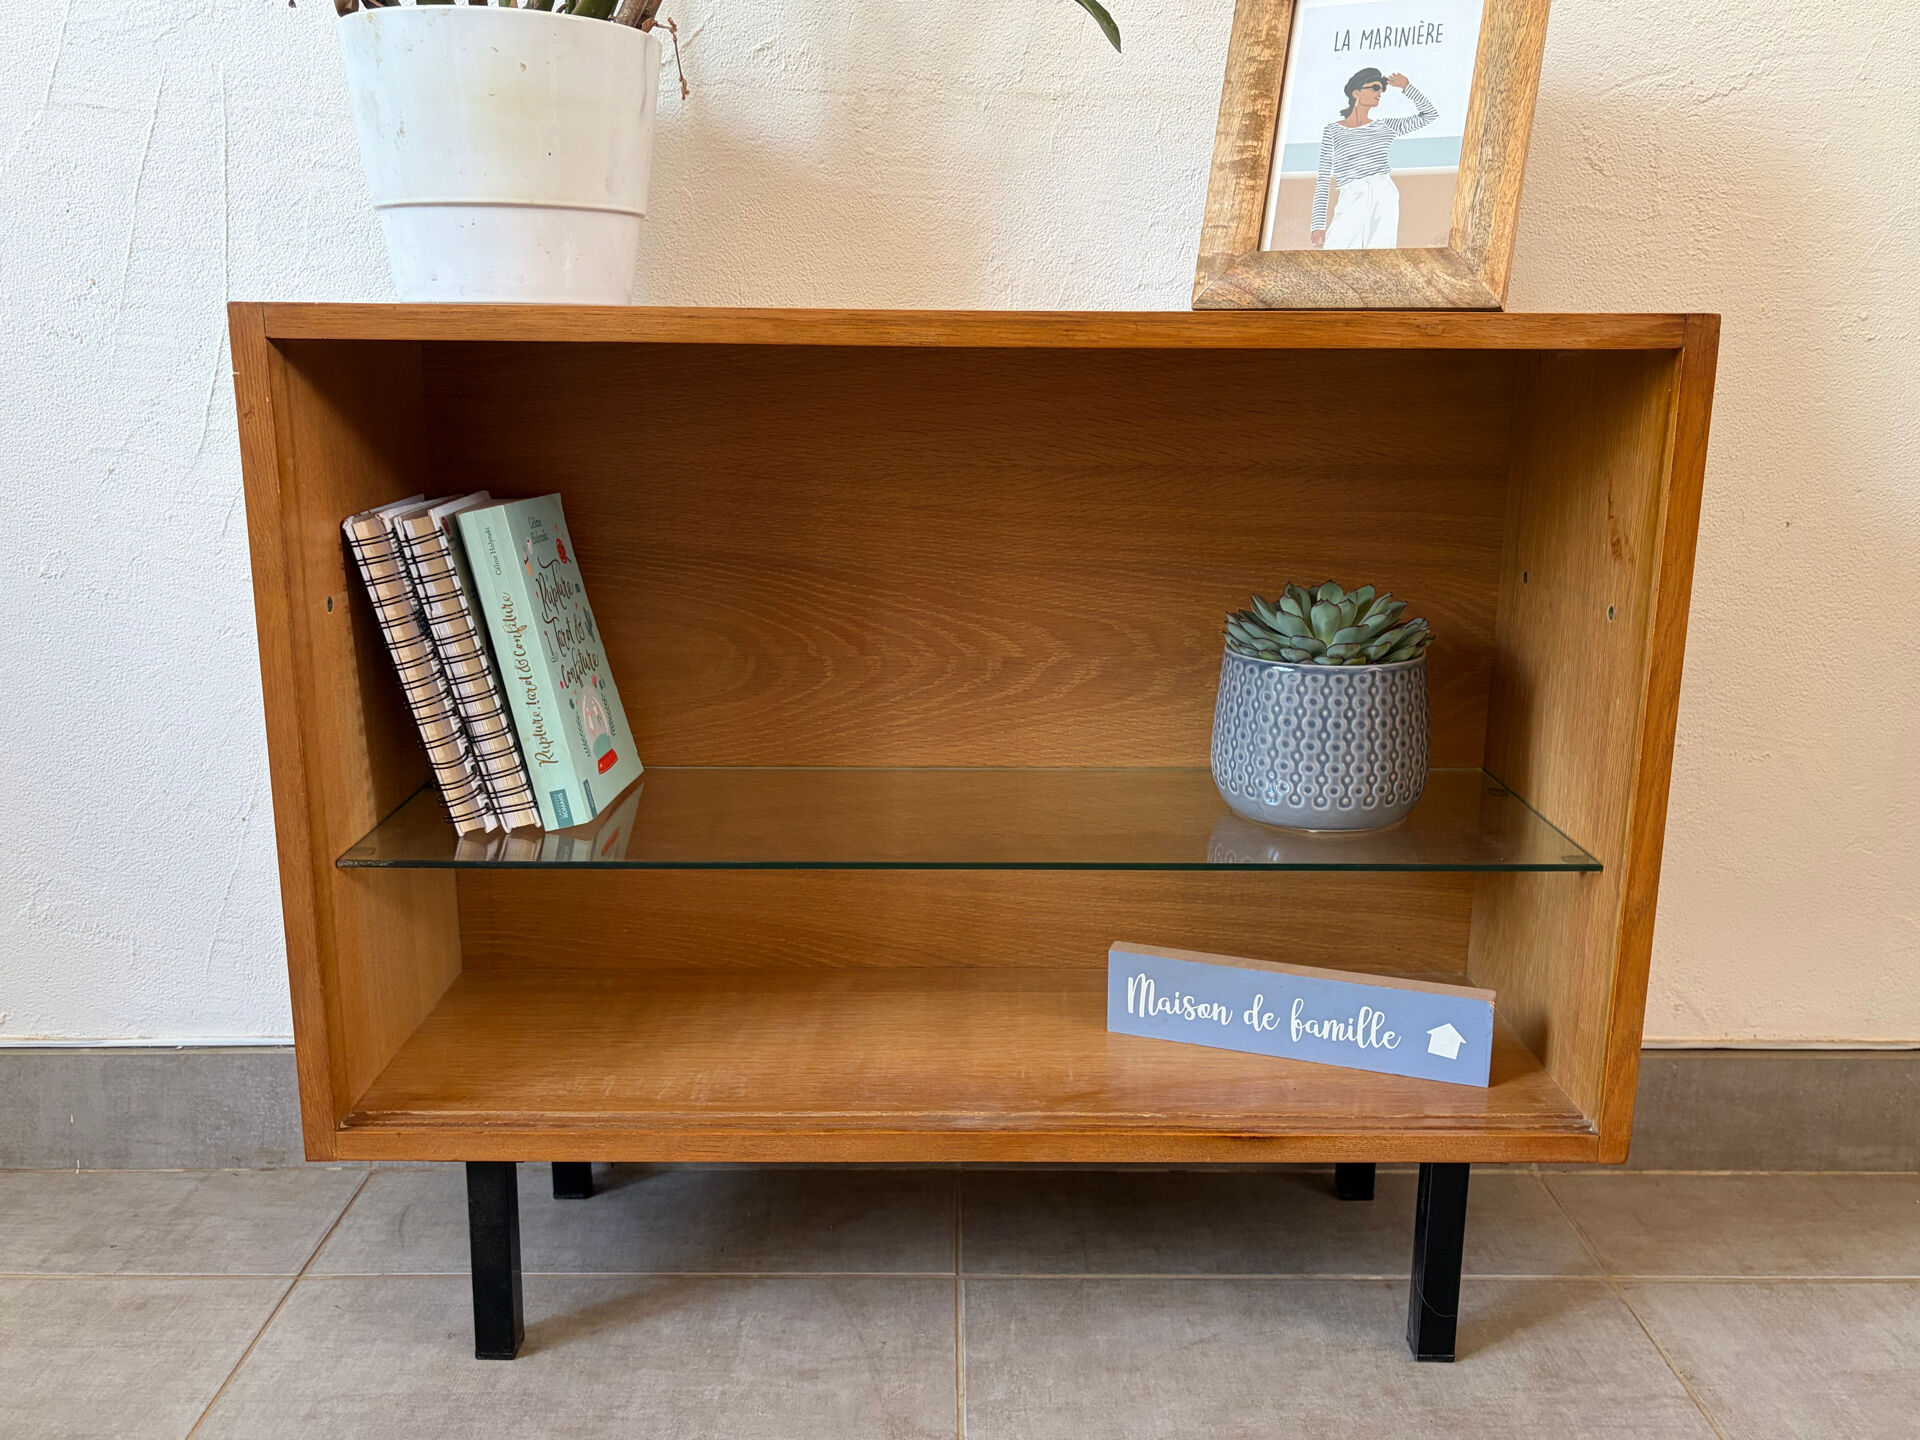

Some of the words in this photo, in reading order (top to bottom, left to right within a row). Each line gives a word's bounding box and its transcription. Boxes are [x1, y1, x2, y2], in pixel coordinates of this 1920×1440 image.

[1334, 29, 1350, 51] LA
[1359, 20, 1443, 50] MARINIÈRE
[515, 659, 531, 673] &
[557, 792, 569, 819] ROMANS
[1127, 972, 1233, 1027] Maison
[1243, 994, 1280, 1031] de
[1290, 998, 1401, 1050] famille
